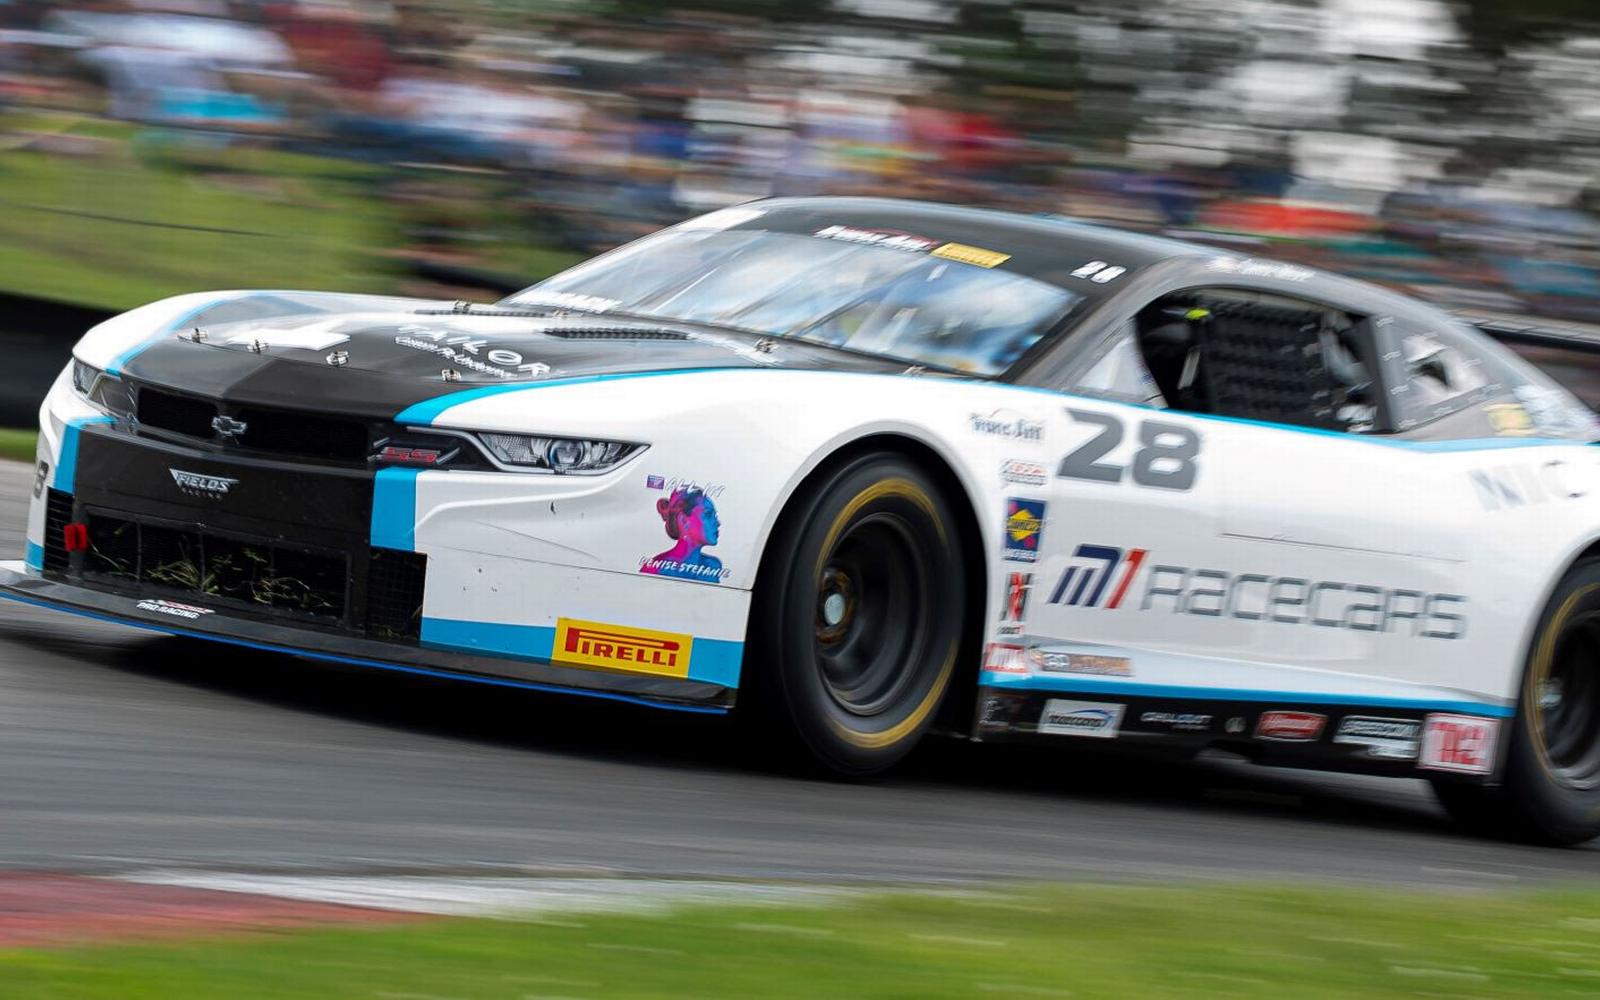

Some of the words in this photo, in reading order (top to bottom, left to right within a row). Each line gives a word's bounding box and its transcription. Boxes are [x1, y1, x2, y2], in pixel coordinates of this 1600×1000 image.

[1056, 407, 1201, 492] 28
[169, 468, 240, 493] FIELDS
[638, 556, 678, 571] DENISE
[680, 563, 732, 579] STEFANIE
[565, 627, 680, 667] PIRELLI
